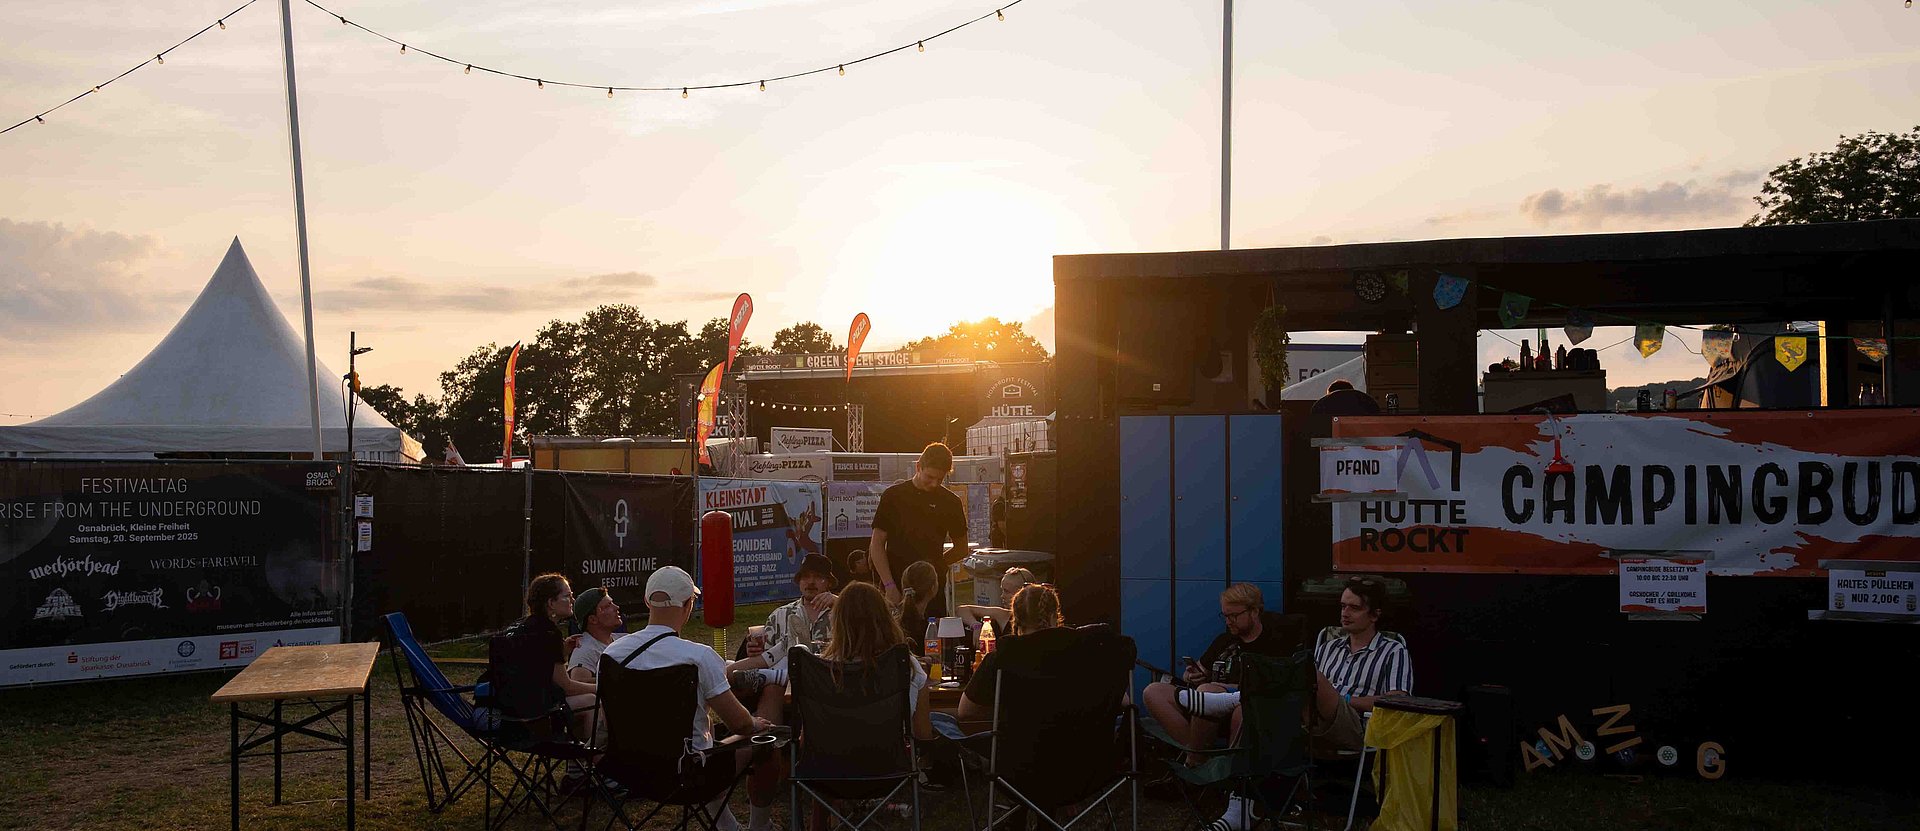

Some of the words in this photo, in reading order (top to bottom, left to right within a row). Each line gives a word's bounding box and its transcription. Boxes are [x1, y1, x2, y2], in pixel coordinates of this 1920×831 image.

[807, 354, 840, 368] GREEN
[843, 352, 873, 367] SEEL
[877, 352, 909, 366] STAGE
[986, 377, 1015, 399] NONPROFIT
[1017, 377, 1039, 397] FESTIVAL
[992, 404, 1033, 417] HÜTTE
[1337, 460, 1380, 476] PFAND
[306, 471, 329, 480] OSNA
[81, 478, 188, 494] FESTIVALTAG
[706, 486, 767, 509] KLEINSTADT
[0, 502, 36, 519] RISE
[43, 502, 93, 518] FROM
[99, 501, 133, 518] THE
[138, 500, 261, 517] UNDERGROUND
[78, 523, 128, 534] Osnabrück,
[130, 522, 157, 532] Kleine
[159, 522, 190, 532] Freiheit
[69, 535, 112, 545] Samstag,
[113, 534, 127, 543] 20.
[129, 533, 175, 544] September
[177, 532, 199, 542] 2025
[733, 538, 771, 552] EONIDEN
[1361, 527, 1469, 553] ROCKT
[150, 558, 197, 570] WORDS
[202, 556, 259, 568] FAREWELL
[581, 557, 658, 575] SUMMERTIME
[734, 564, 759, 574] PENCER
[602, 576, 639, 588] FESTIVAL
[1837, 579, 1868, 589] KALTES
[1871, 579, 1914, 590] PÜLLEKEN
[1852, 594, 1869, 603] NUR
[1872, 594, 1900, 605] 2,00€
[223, 648, 236, 657] 21
[10, 663, 37, 671] Gefördert
[38, 661, 56, 669] durch:
[82, 655, 109, 664] Stiftung
[116, 660, 152, 670] Osnabrück
